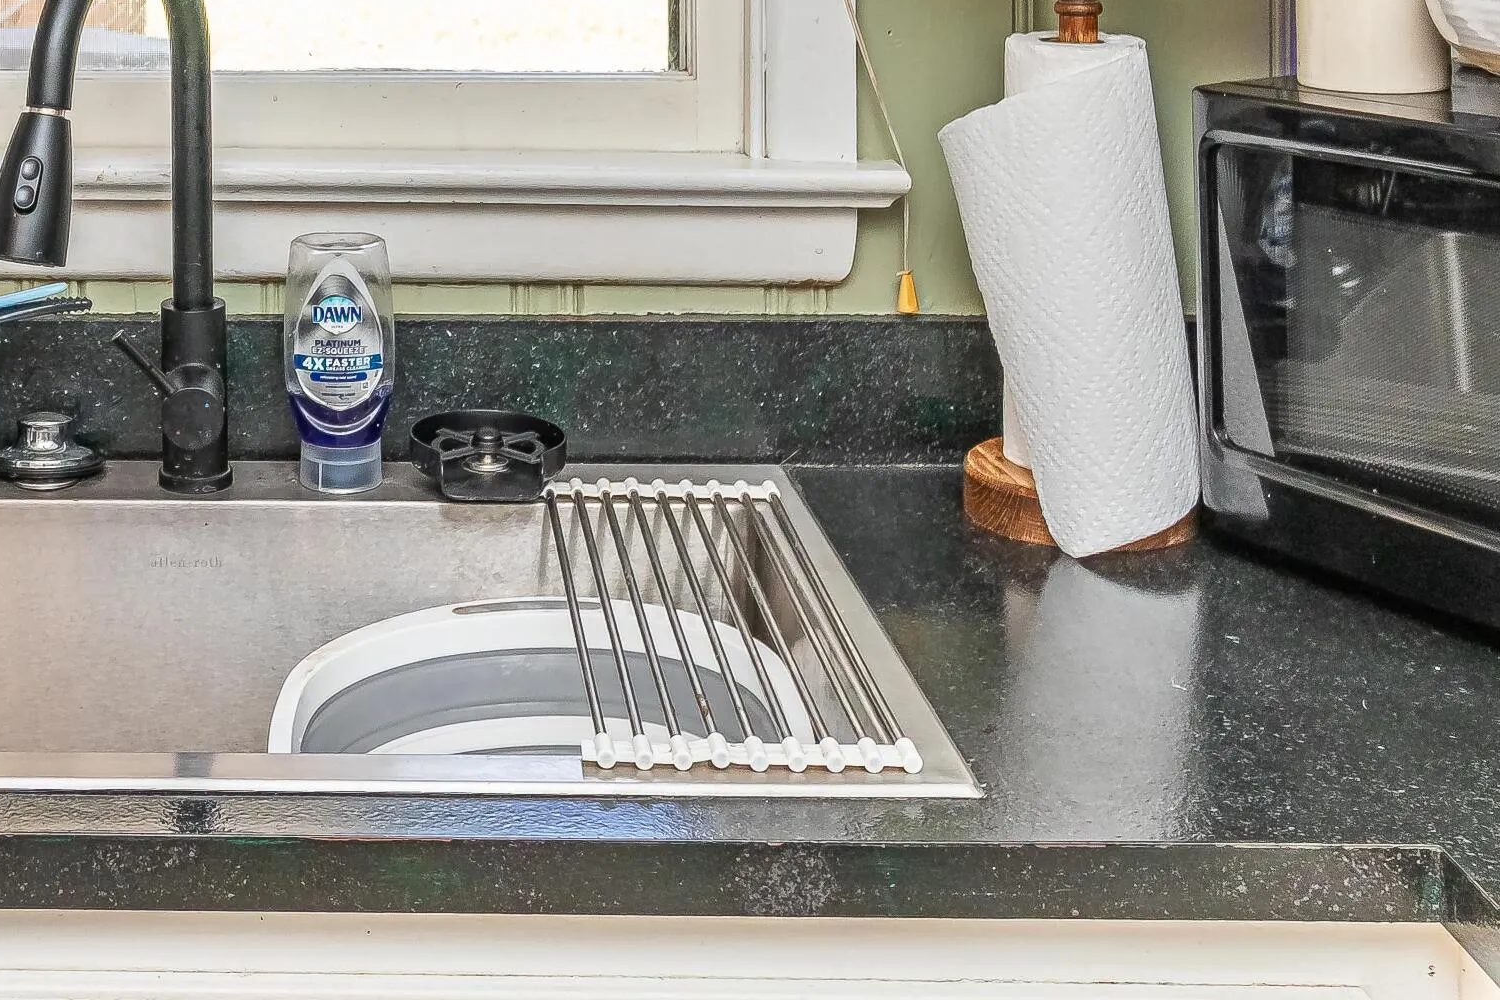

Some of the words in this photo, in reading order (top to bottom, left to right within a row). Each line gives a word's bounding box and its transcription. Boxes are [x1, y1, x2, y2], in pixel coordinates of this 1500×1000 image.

[312, 305, 362, 323] DAWN
[314, 339, 361, 348] PLATINUM
[302, 356, 324, 370] 4X
[326, 356, 370, 366] FASTER
